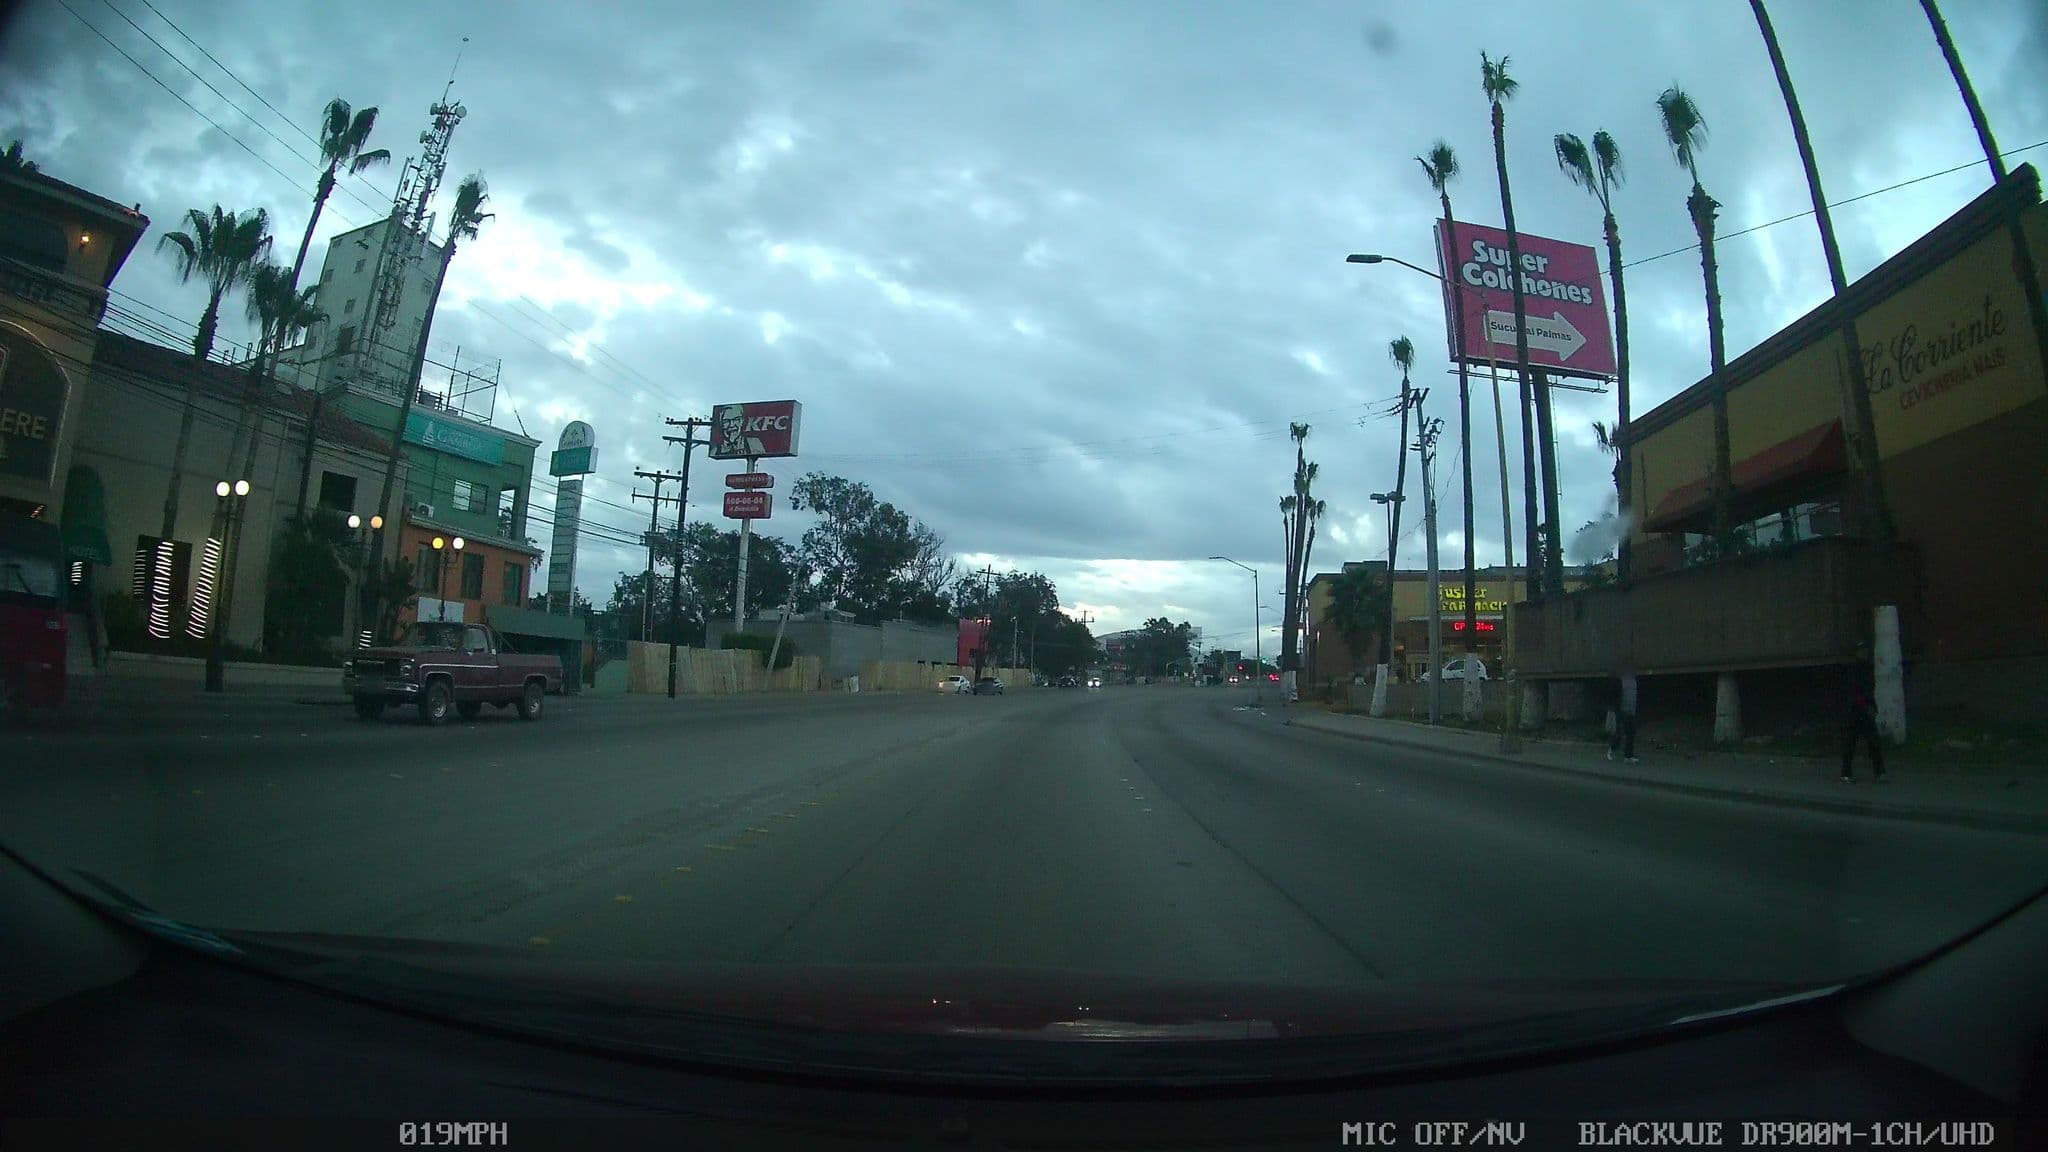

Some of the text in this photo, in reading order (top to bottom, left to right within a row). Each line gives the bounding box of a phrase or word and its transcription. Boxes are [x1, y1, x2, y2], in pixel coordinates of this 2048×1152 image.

[1490, 321, 1572, 342] Sucual Palmas
[1861, 293, 2006, 394] La Corriente
[744, 415, 789, 432] KFC
